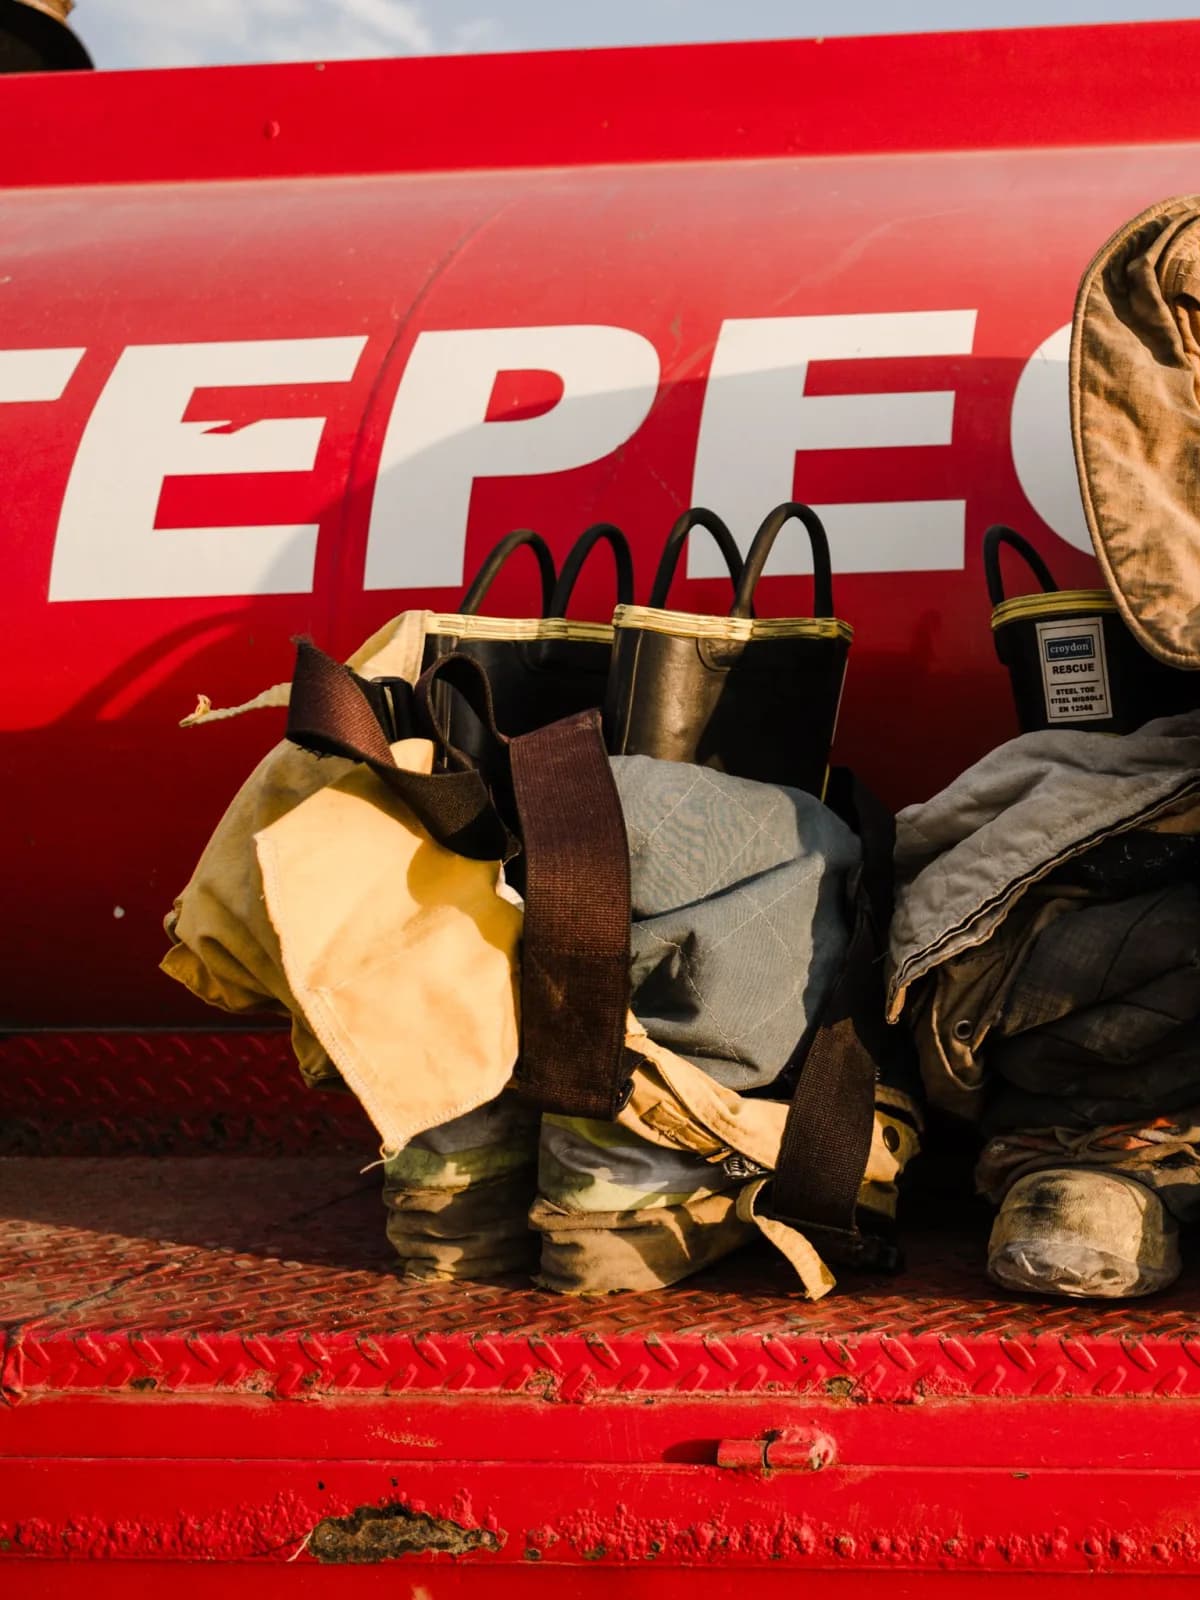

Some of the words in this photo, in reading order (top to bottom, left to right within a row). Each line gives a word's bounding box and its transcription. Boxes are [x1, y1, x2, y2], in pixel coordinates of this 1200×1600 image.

[0, 309, 1096, 602] EPE
[1050, 642, 1089, 654] croydon
[1052, 663, 1094, 675] RESCUE
[1056, 688, 1078, 696] STEEL
[1080, 686, 1095, 694] TOE
